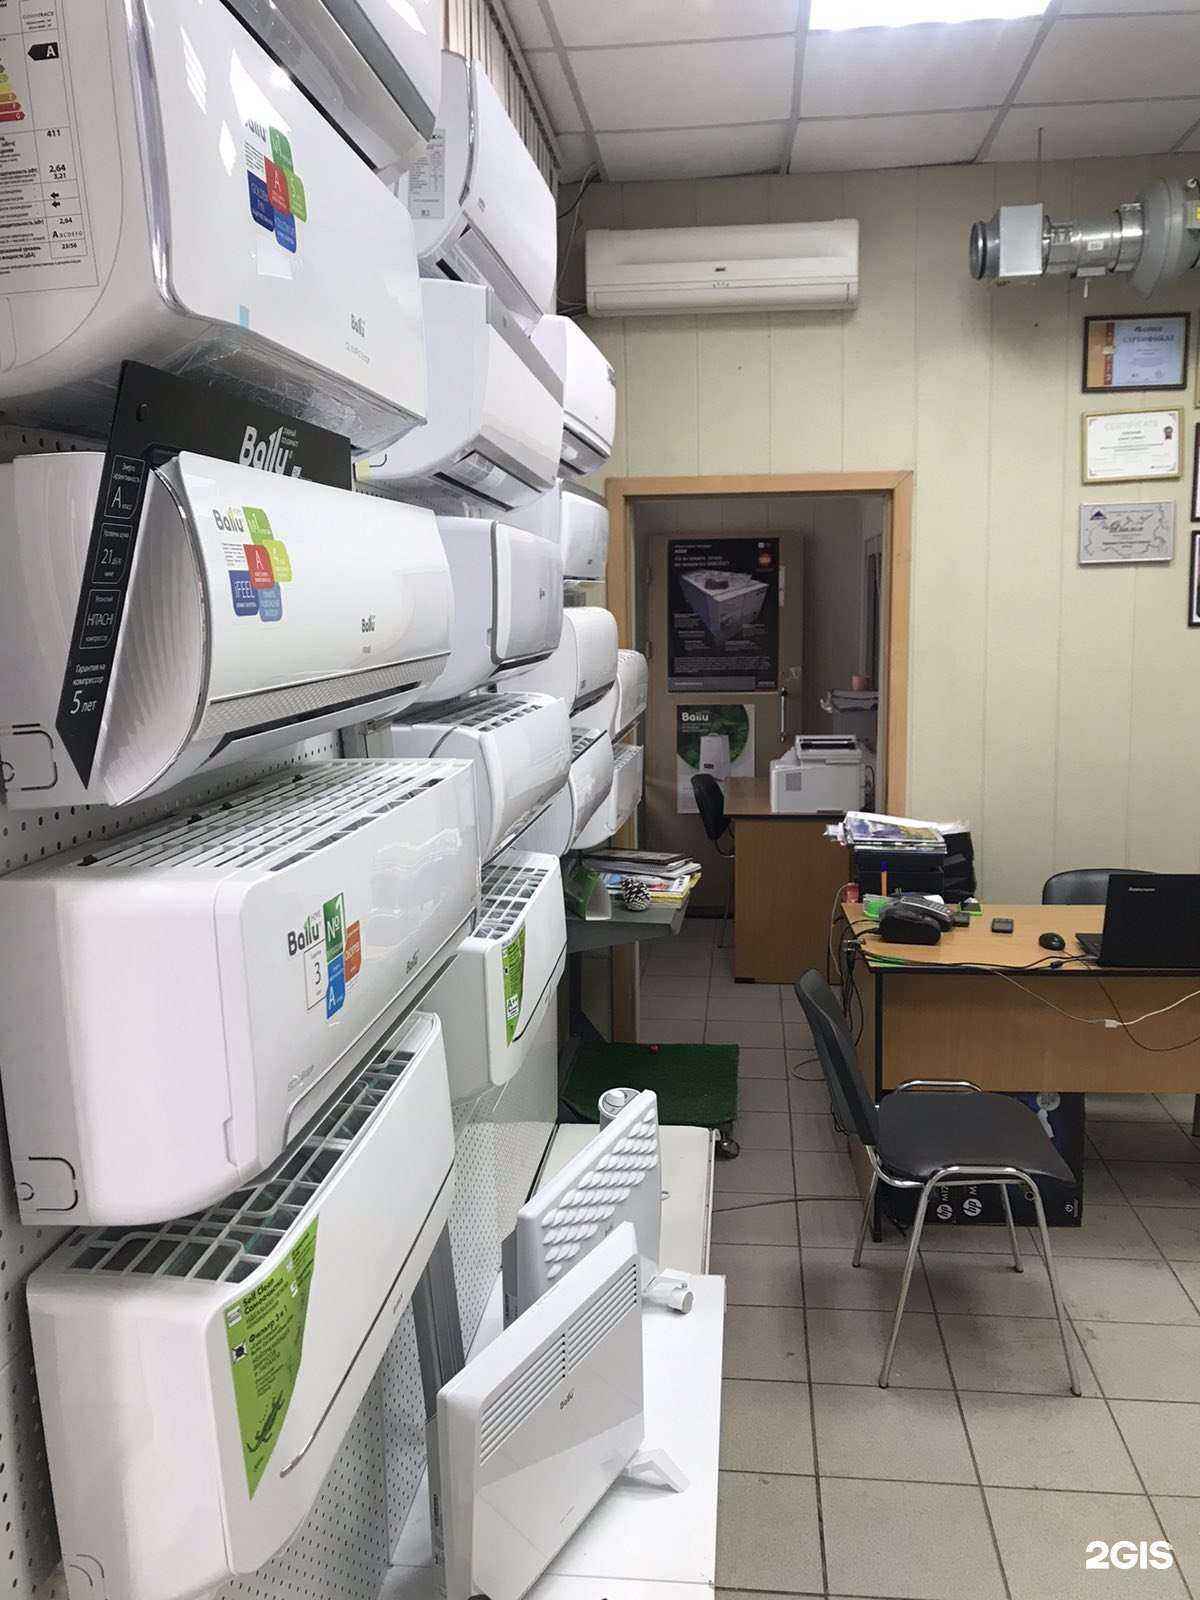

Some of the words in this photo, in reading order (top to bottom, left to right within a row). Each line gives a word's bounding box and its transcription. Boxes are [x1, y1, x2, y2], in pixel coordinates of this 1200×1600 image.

[46, 45, 56, 57] A
[47, 129, 61, 137] 411
[49, 164, 66, 173] 2,64
[239, 424, 290, 475] Ballu
[212, 508, 245, 533] Ballu
[101, 548, 113, 564] 21
[86, 612, 115, 626] HITACHI
[75, 663, 98, 674] Гарантия
[70, 690, 83, 714] 5
[81, 700, 98, 713] лет
[681, 711, 709, 722] Ballu
[287, 914, 320, 957] Ballu
[312, 961, 322, 985] 3
